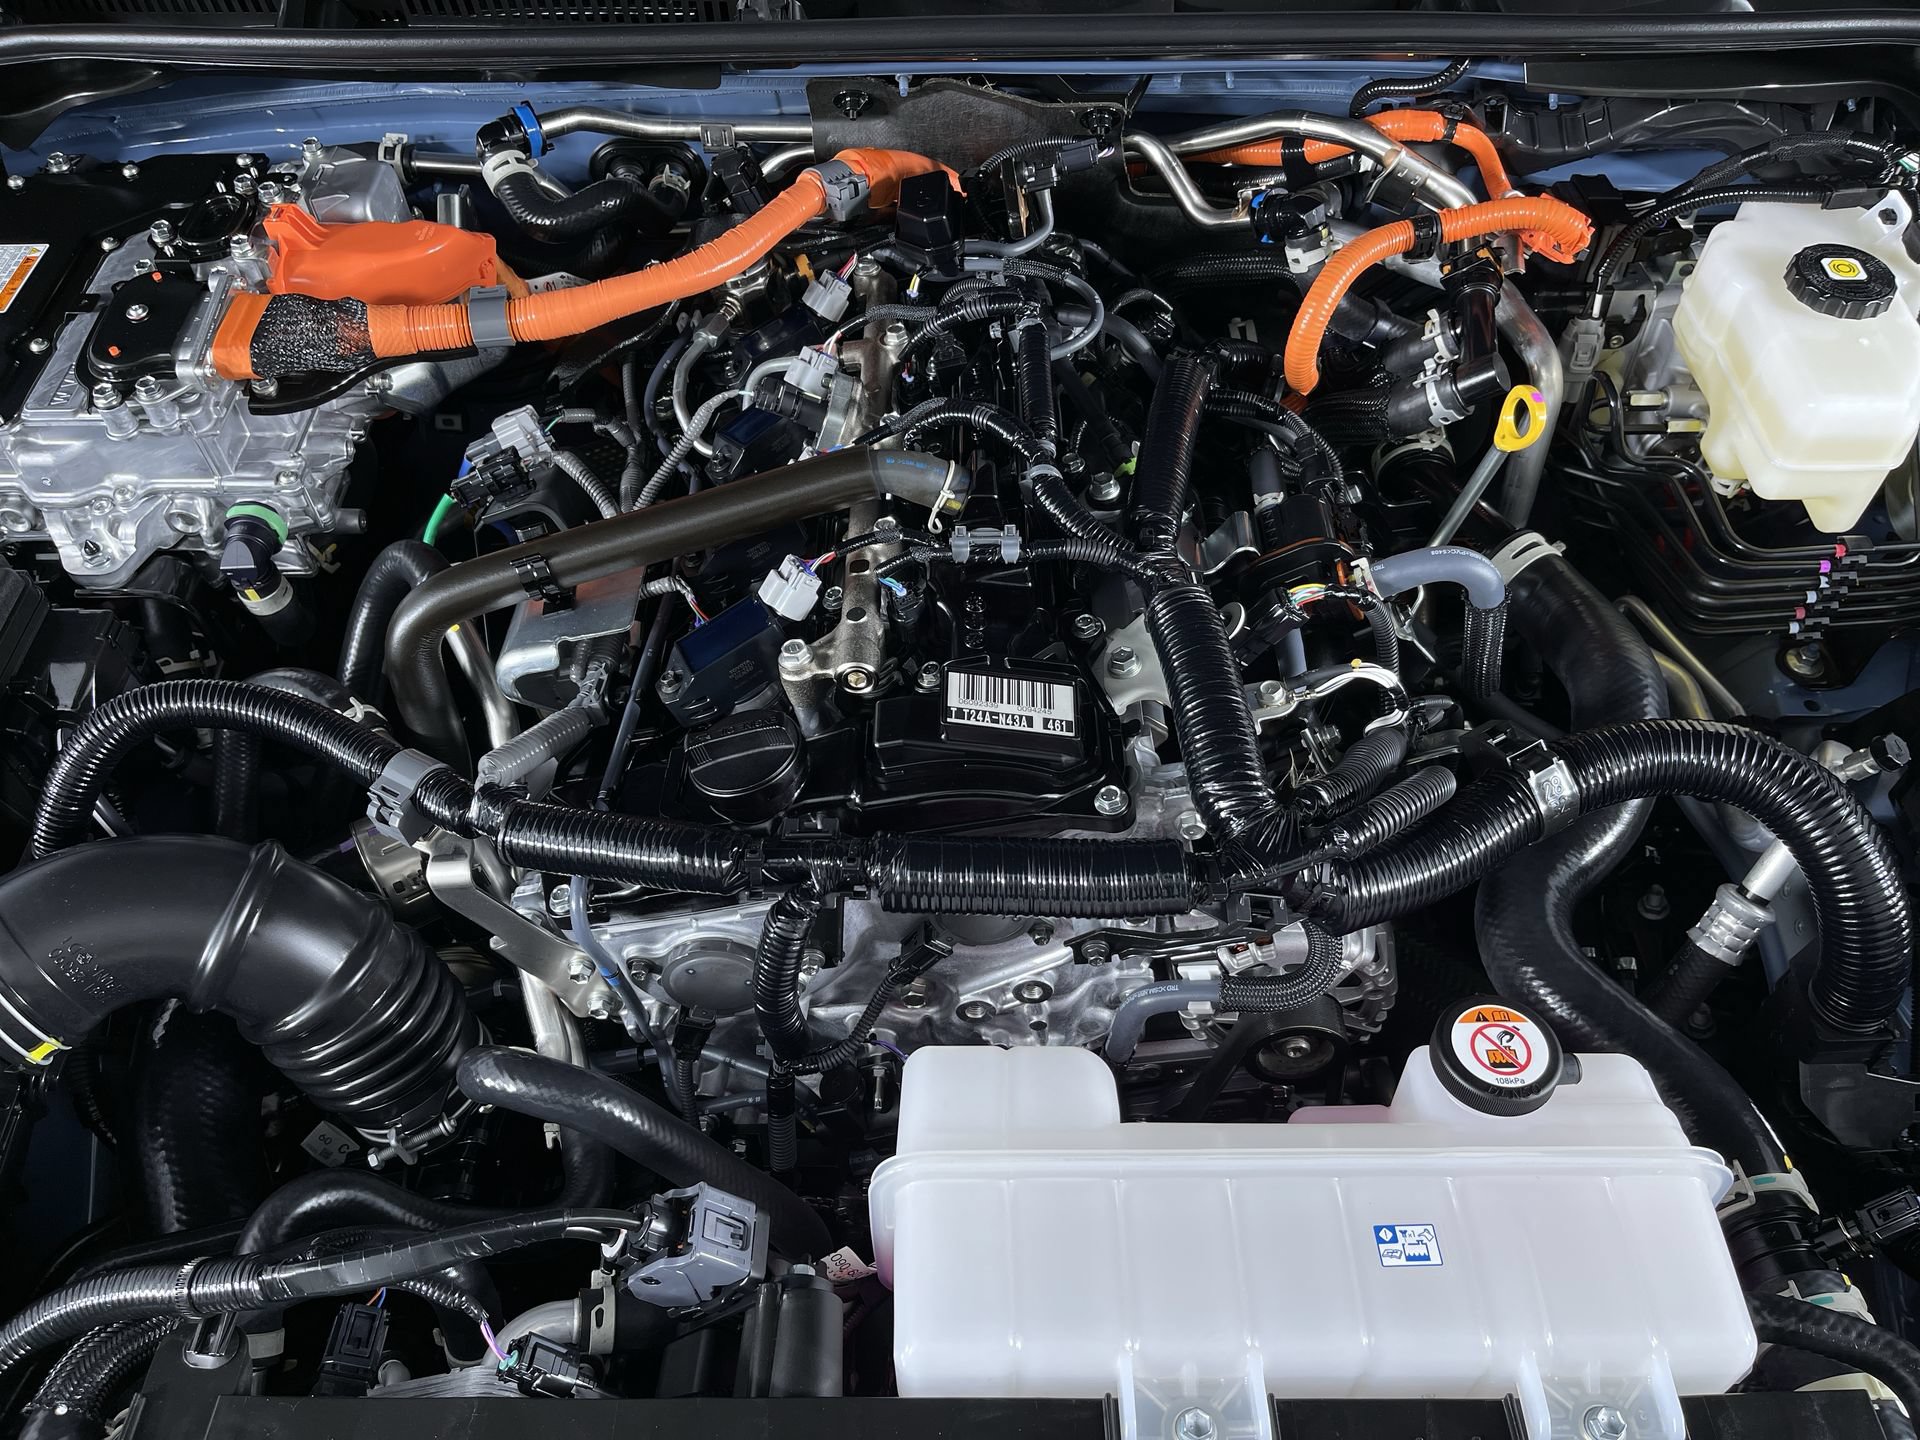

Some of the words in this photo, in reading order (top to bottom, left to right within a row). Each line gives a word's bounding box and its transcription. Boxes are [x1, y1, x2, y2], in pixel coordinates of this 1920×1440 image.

[958, 698, 999, 709] 06092339
[1017, 705, 1052, 715] 0094245
[951, 707, 957, 719] T
[963, 709, 1028, 728] T24A-N43A
[1047, 719, 1067, 732] 461
[1542, 776, 1564, 801] 28
[1495, 1077, 1526, 1085] 108kPa
